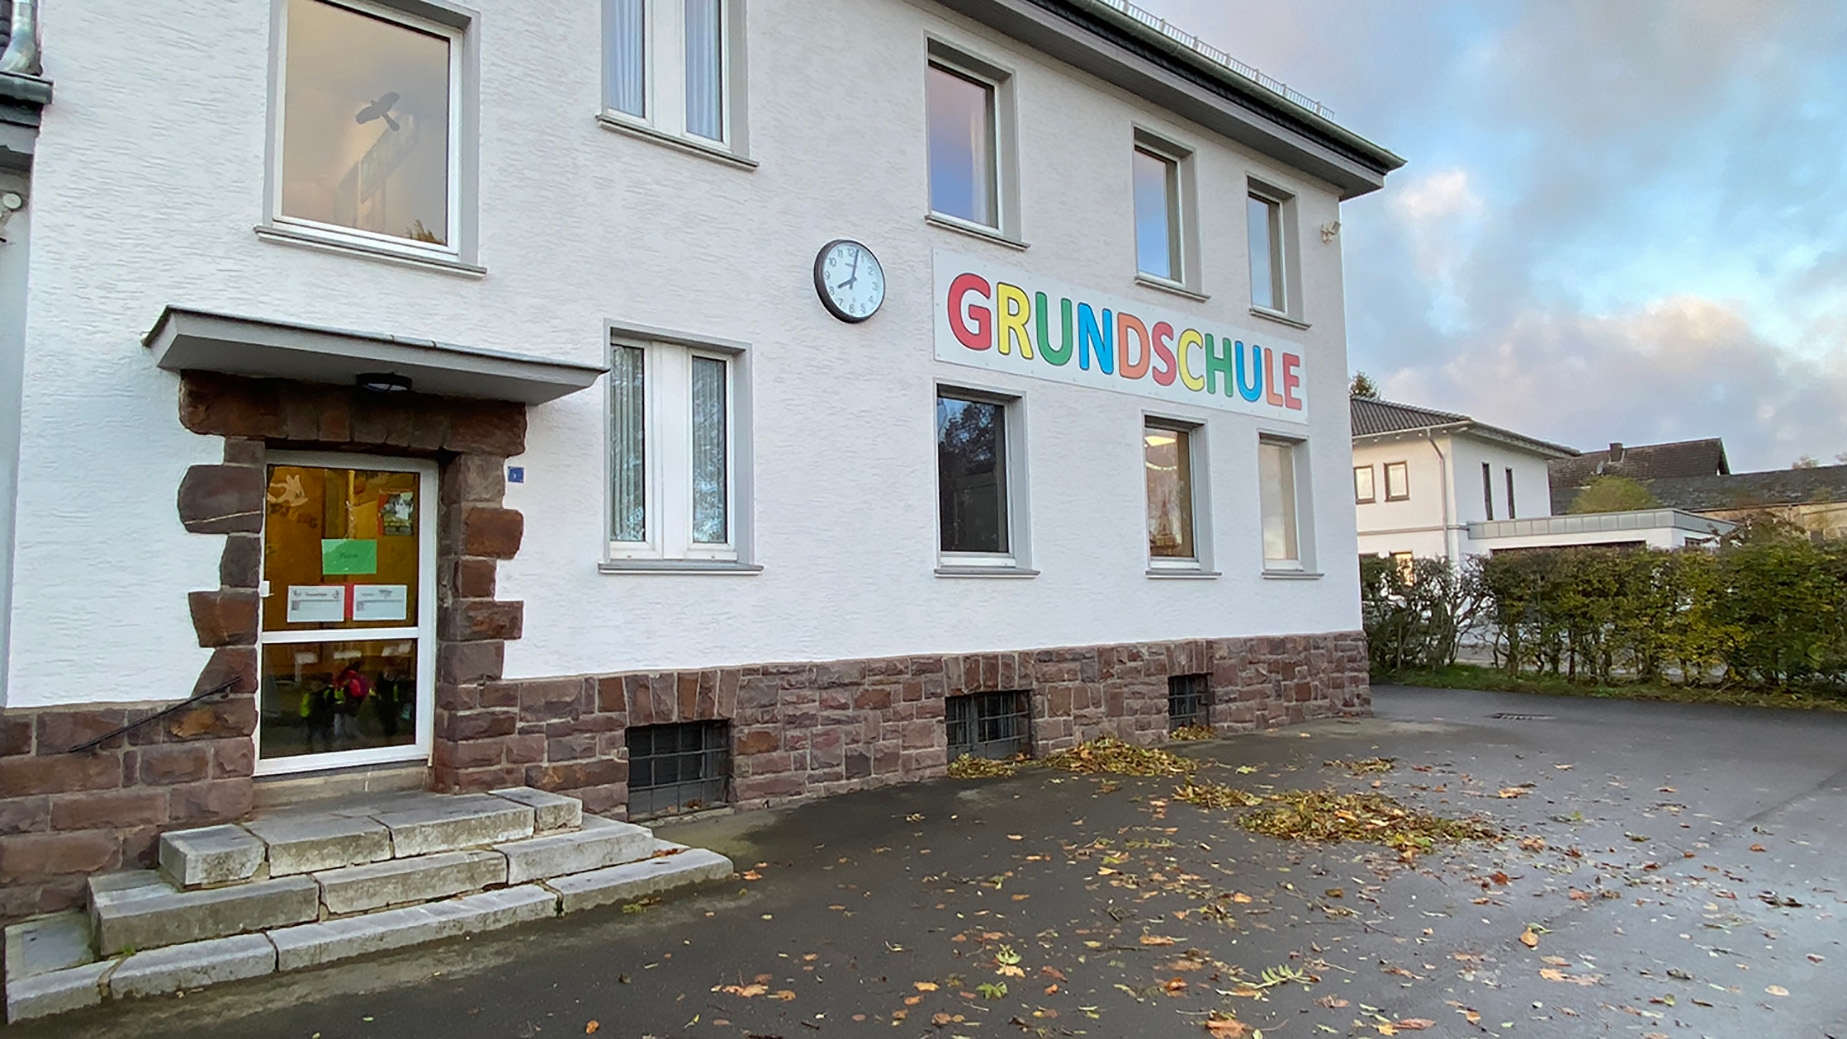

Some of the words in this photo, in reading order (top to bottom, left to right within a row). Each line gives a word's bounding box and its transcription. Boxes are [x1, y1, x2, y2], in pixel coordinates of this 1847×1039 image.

[837, 248, 844, 258] 11
[847, 248, 855, 257] 12
[829, 257, 837, 267] 10
[824, 270, 830, 280] 9
[868, 266, 874, 276] 2
[829, 286, 835, 295] 8
[872, 282, 878, 291] 3
[838, 298, 844, 306] 7
[849, 304, 855, 313] 6
[860, 303, 866, 313] 5
[948, 272, 1302, 411] GRUNDSCHULE
